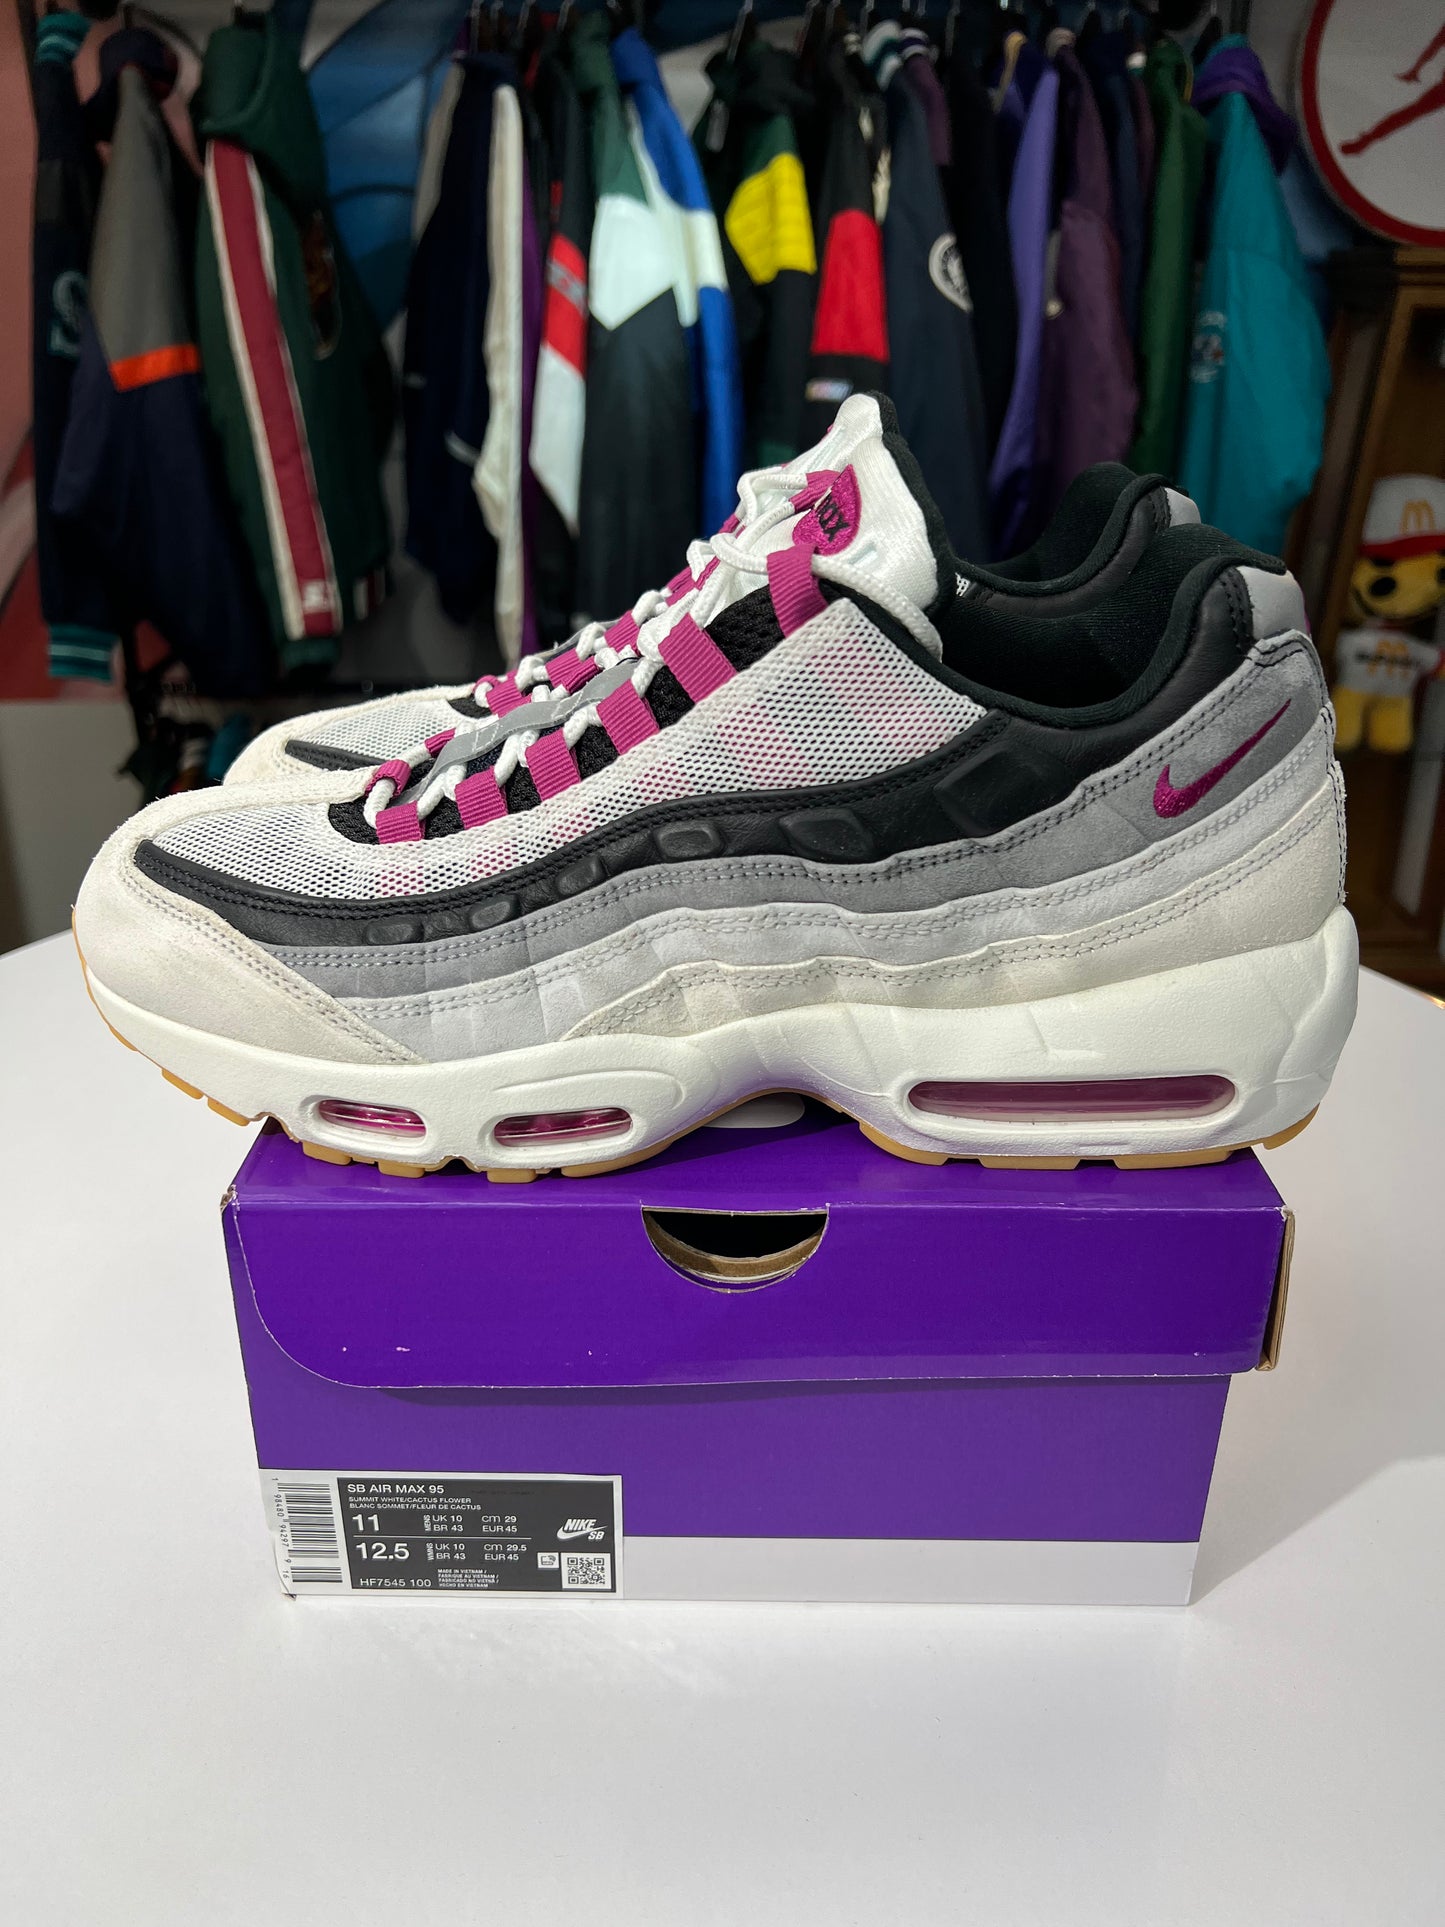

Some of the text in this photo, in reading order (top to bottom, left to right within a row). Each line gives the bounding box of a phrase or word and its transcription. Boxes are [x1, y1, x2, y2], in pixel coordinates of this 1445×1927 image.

[347, 1484, 445, 1494] SB AIR MAX 95
[352, 1514, 380, 1531] 11
[424, 1514, 432, 1532] MENS
[564, 1518, 597, 1530] NIKE
[280, 1524, 290, 1548] 94297
[588, 1531, 605, 1540] SB
[356, 1542, 410, 1560] 12.5
[360, 1578, 432, 1587] HF7545 100
